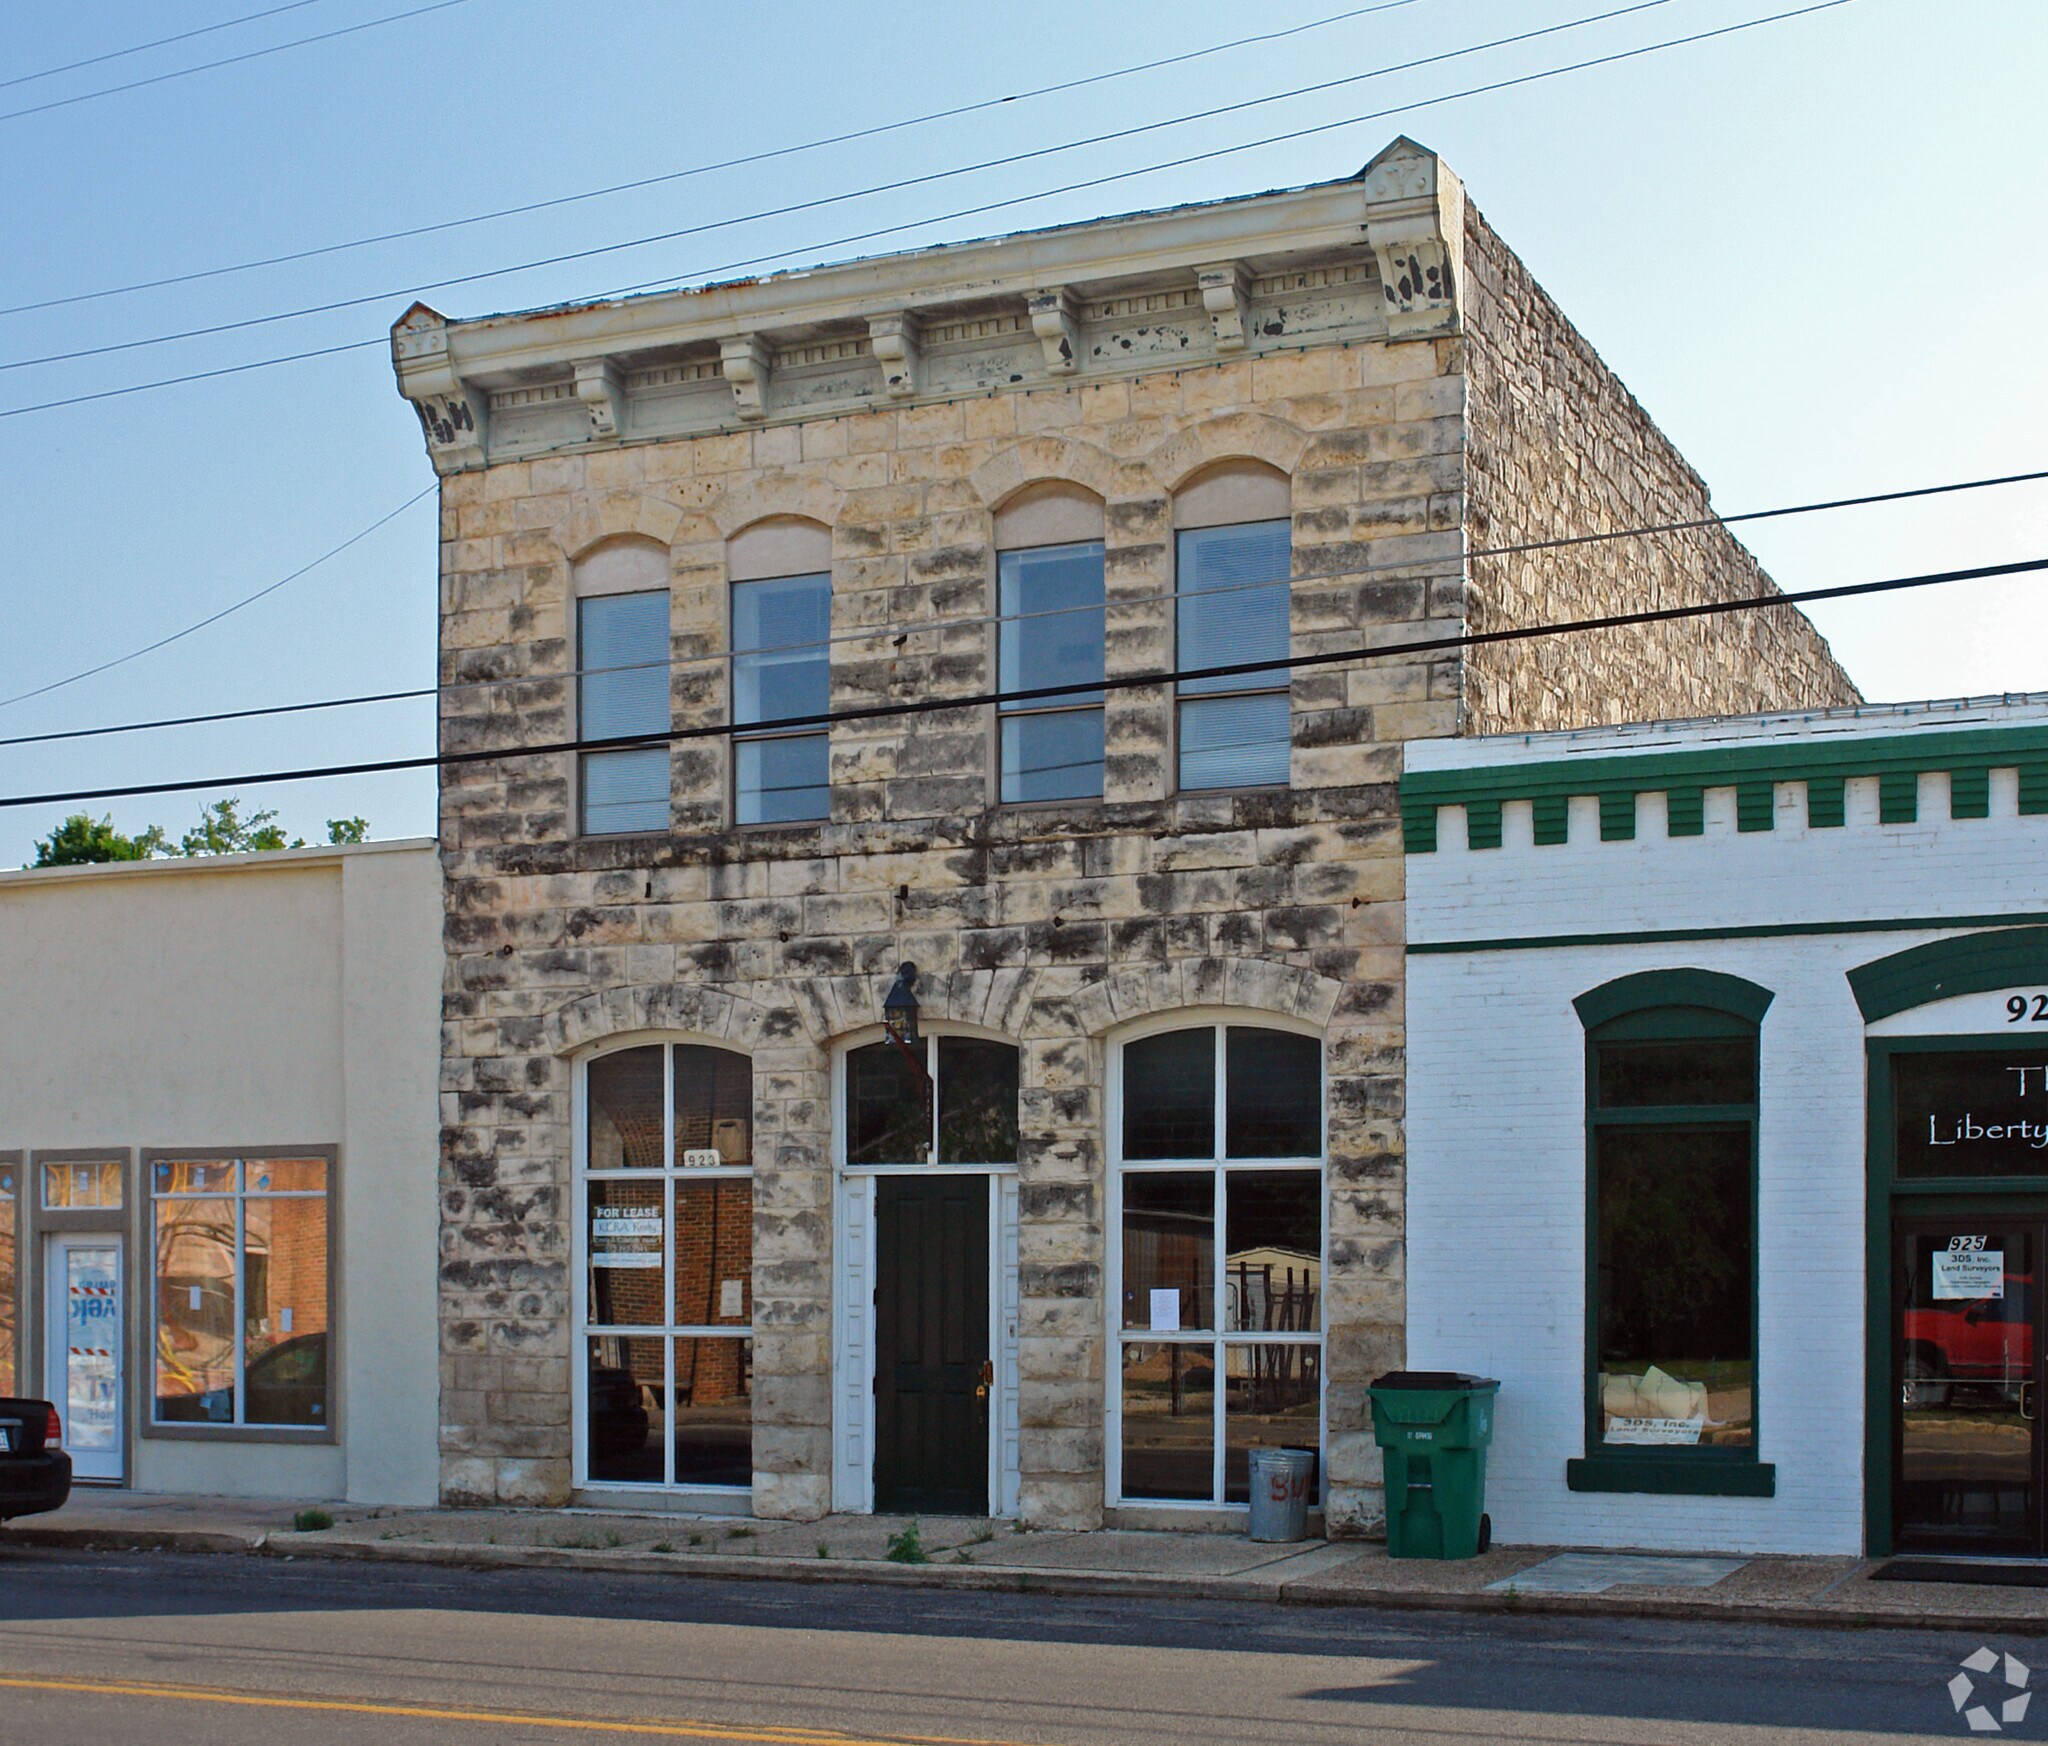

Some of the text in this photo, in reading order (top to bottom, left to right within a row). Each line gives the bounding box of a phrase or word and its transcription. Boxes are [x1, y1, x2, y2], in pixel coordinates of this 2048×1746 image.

[1929, 1113, 2048, 1149] Liberty
[688, 1154, 716, 1167] 923
[596, 1208, 659, 1218] FOR LEASE
[1949, 1236, 1985, 1251] 925
[1951, 1254, 1972, 1263] 3DS
[1941, 1264, 2001, 1273] Land Surveyors
[1663, 1419, 1690, 1428] Inc.
[1641, 1427, 1700, 1435] Surveyors
